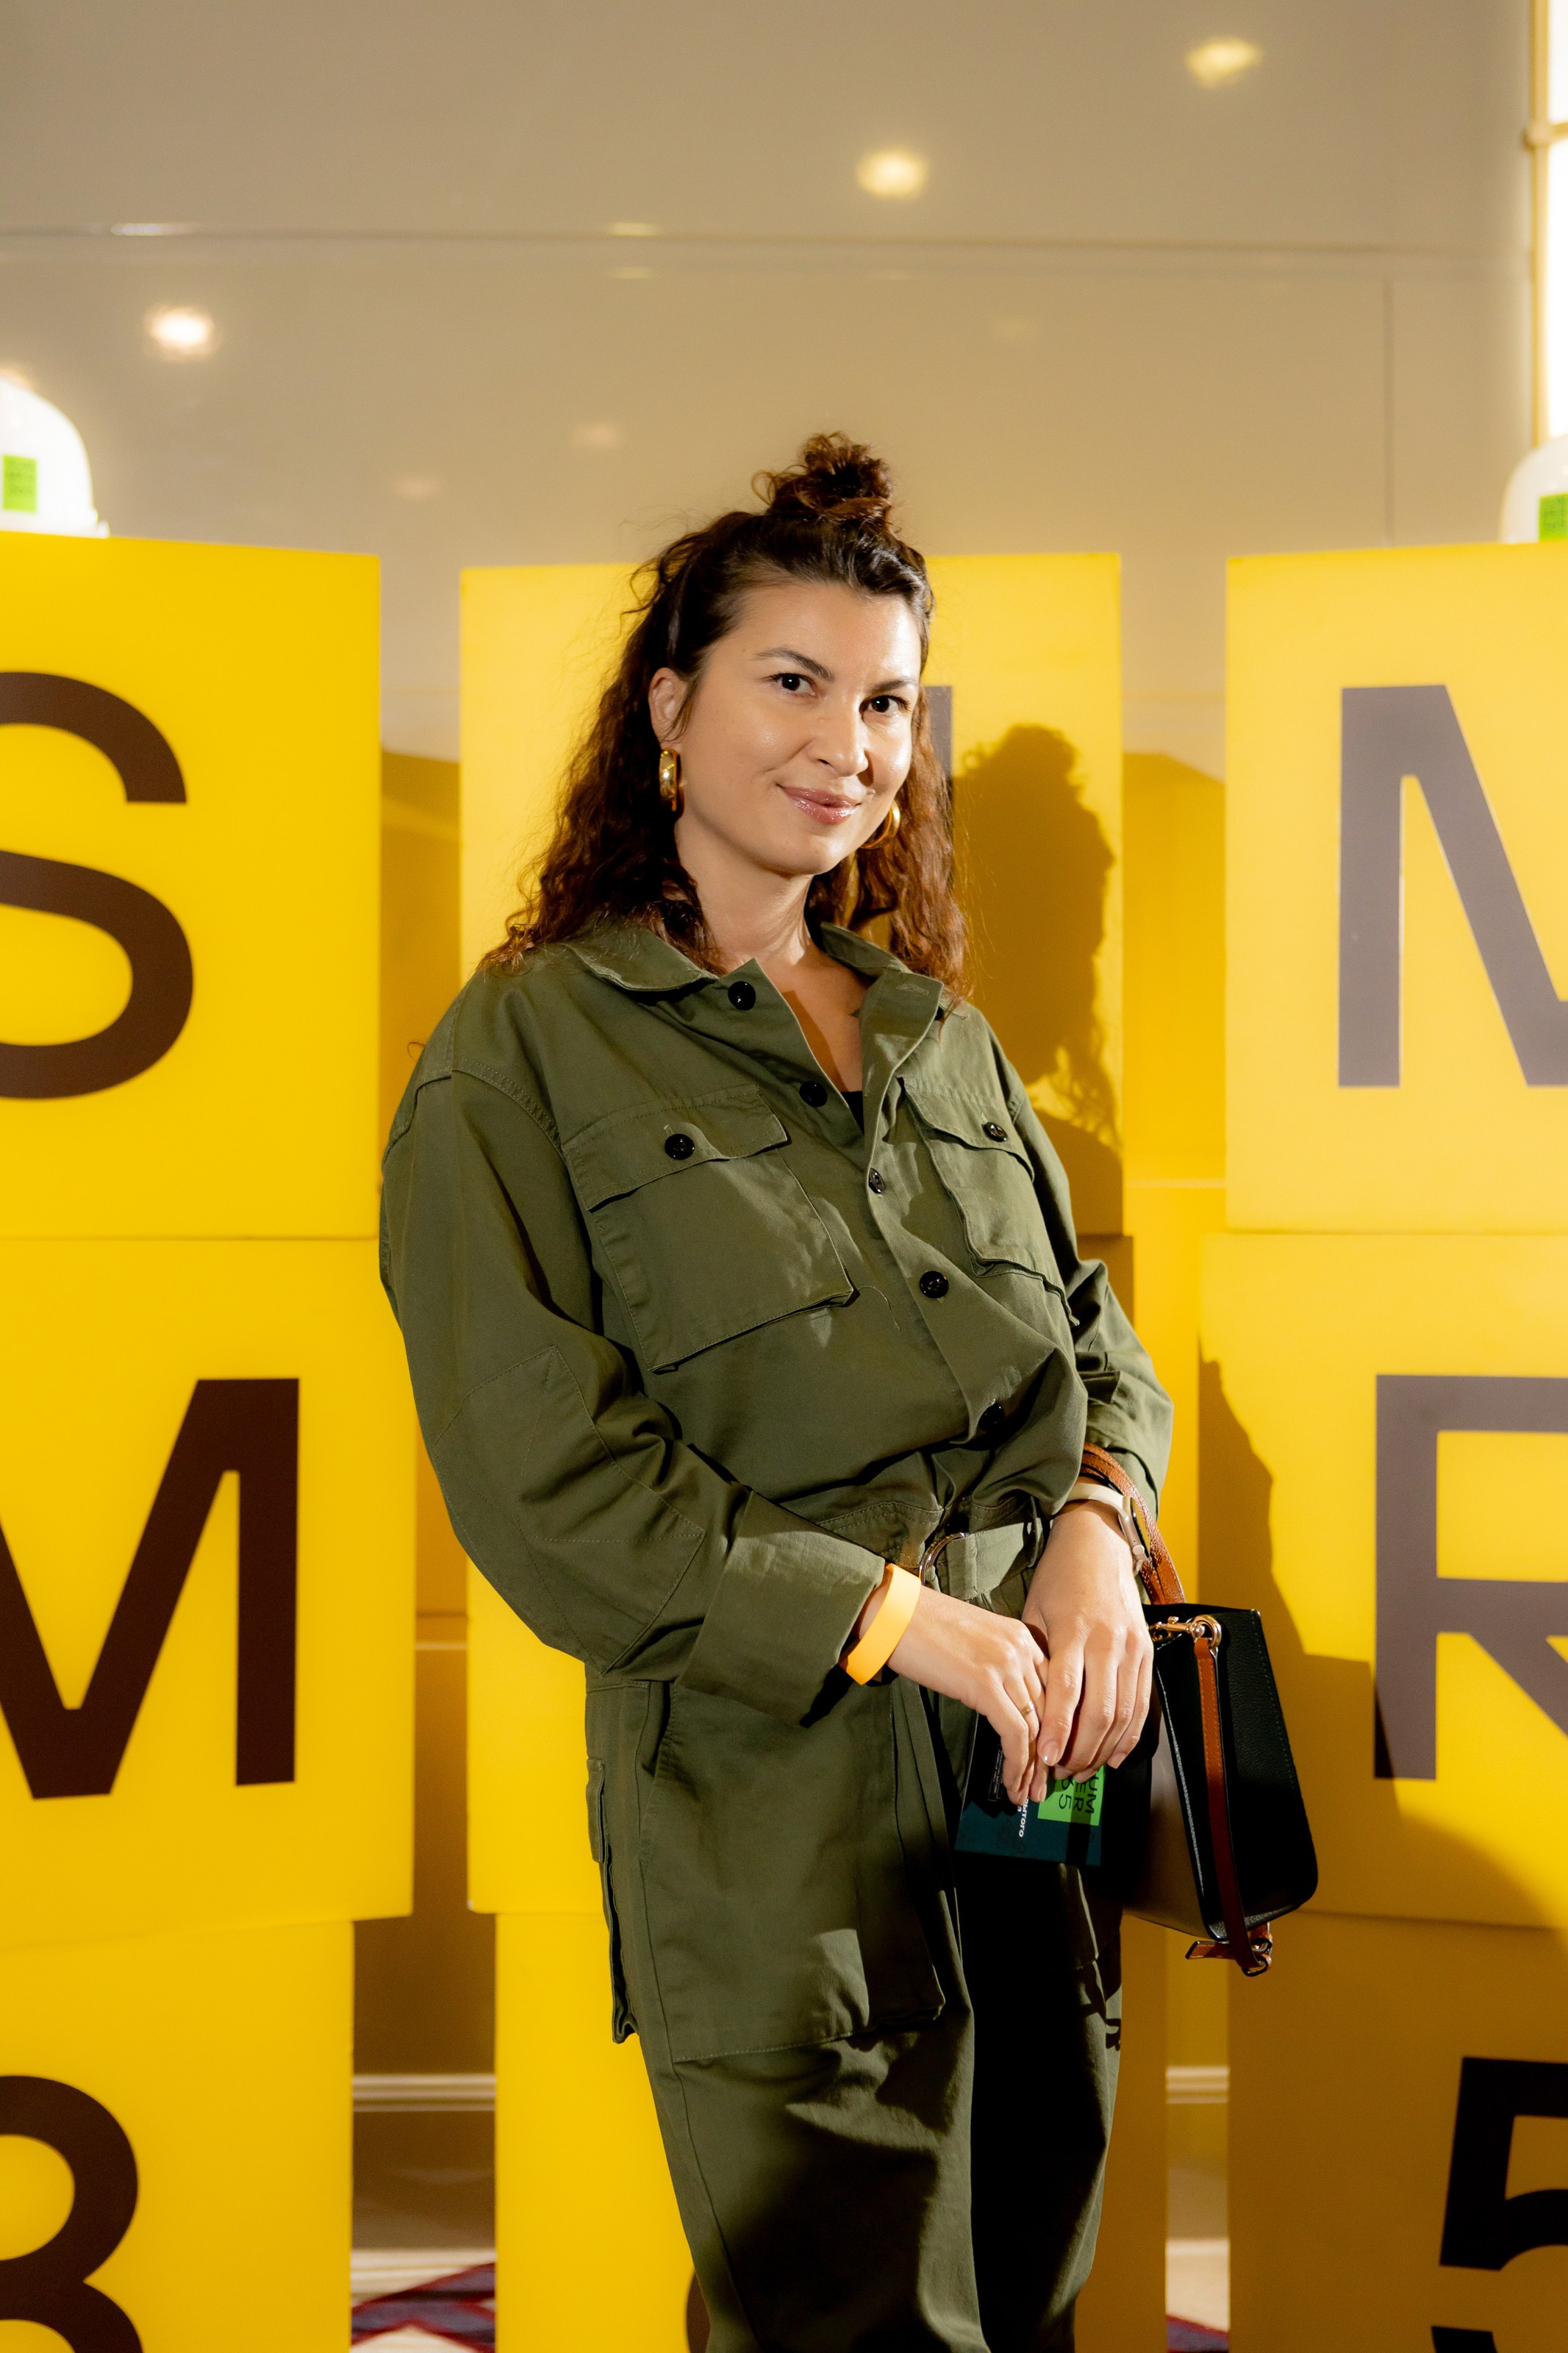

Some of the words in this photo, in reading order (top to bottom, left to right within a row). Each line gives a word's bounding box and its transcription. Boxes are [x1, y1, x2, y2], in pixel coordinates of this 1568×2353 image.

[0, 672, 193, 1099] S
[0, 1378, 298, 1800] M
[1059, 1776, 1074, 1810] 65
[1073, 1782, 1086, 1812] ER
[1085, 1776, 1099, 1814] UM
